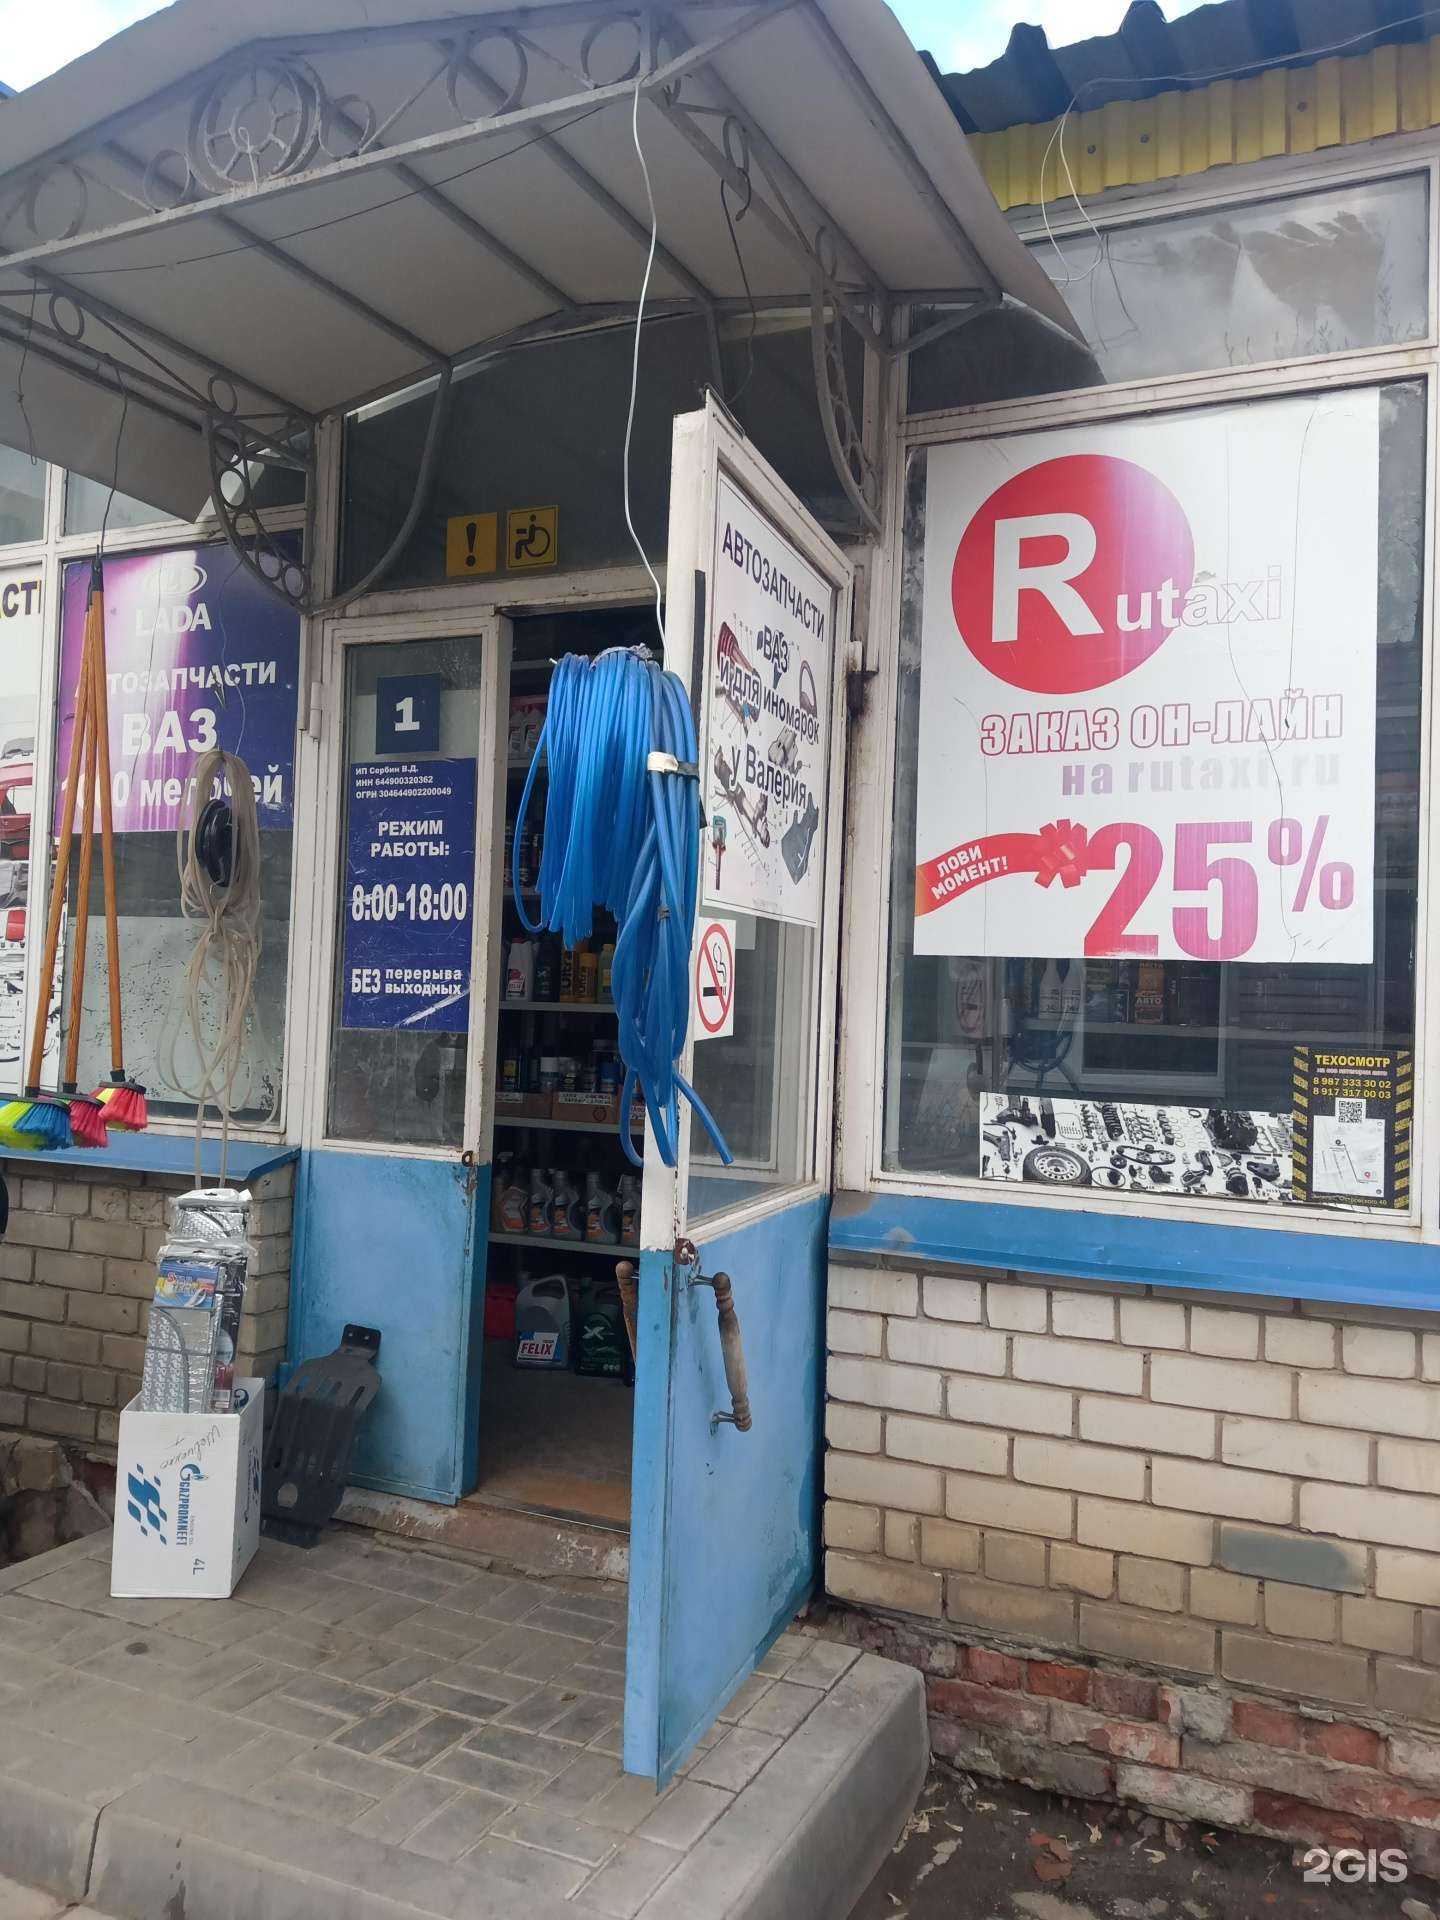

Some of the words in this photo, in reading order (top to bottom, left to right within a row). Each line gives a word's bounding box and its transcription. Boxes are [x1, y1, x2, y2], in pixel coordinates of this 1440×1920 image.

[2, 580, 42, 618] СТ
[722, 522, 826, 643] АВТОЗАПЧАСТИ
[136, 603, 212, 636] LADA
[763, 624, 789, 675] ВАЗ
[75, 661, 277, 697] ТОЗАПЧАСТИ
[395, 697, 420, 731] 1
[763, 686, 820, 745] иномарок
[980, 707, 1120, 756] ЗАКАЗ
[1130, 688, 1343, 747] ОН-ЛАЙН
[122, 708, 217, 755] ВАЗ
[355, 767, 368, 775] ИП
[355, 778, 374, 787] ИНН
[746, 742, 807, 811] Валерия
[1062, 763, 1113, 796] на
[355, 790, 377, 798] ОГРН
[378, 820, 443, 836] РЕЖИМ
[370, 841, 450, 857] РАБОТЫ:
[937, 845, 982, 878] ЛОВИ
[931, 856, 1008, 900] МОМЕНТ!
[1083, 814, 1355, 960] 25%
[352, 883, 467, 921] 8:00-18:00
[351, 968, 381, 994] БЕЗ
[385, 969, 462, 981] перерыва
[385, 983, 462, 996] выходных
[1314, 1055, 1391, 1067] ТЕХОСМОТР
[1313, 1077, 1319, 1085] 8
[1321, 1077, 1340, 1085] 987
[1313, 1087, 1319, 1095] 8
[1321, 1088, 1340, 1096] 917
[520, 1343, 553, 1356] FELIX
[176, 1481, 190, 1546] GAZPROMNEFT
[192, 1558, 206, 1575] 4L
